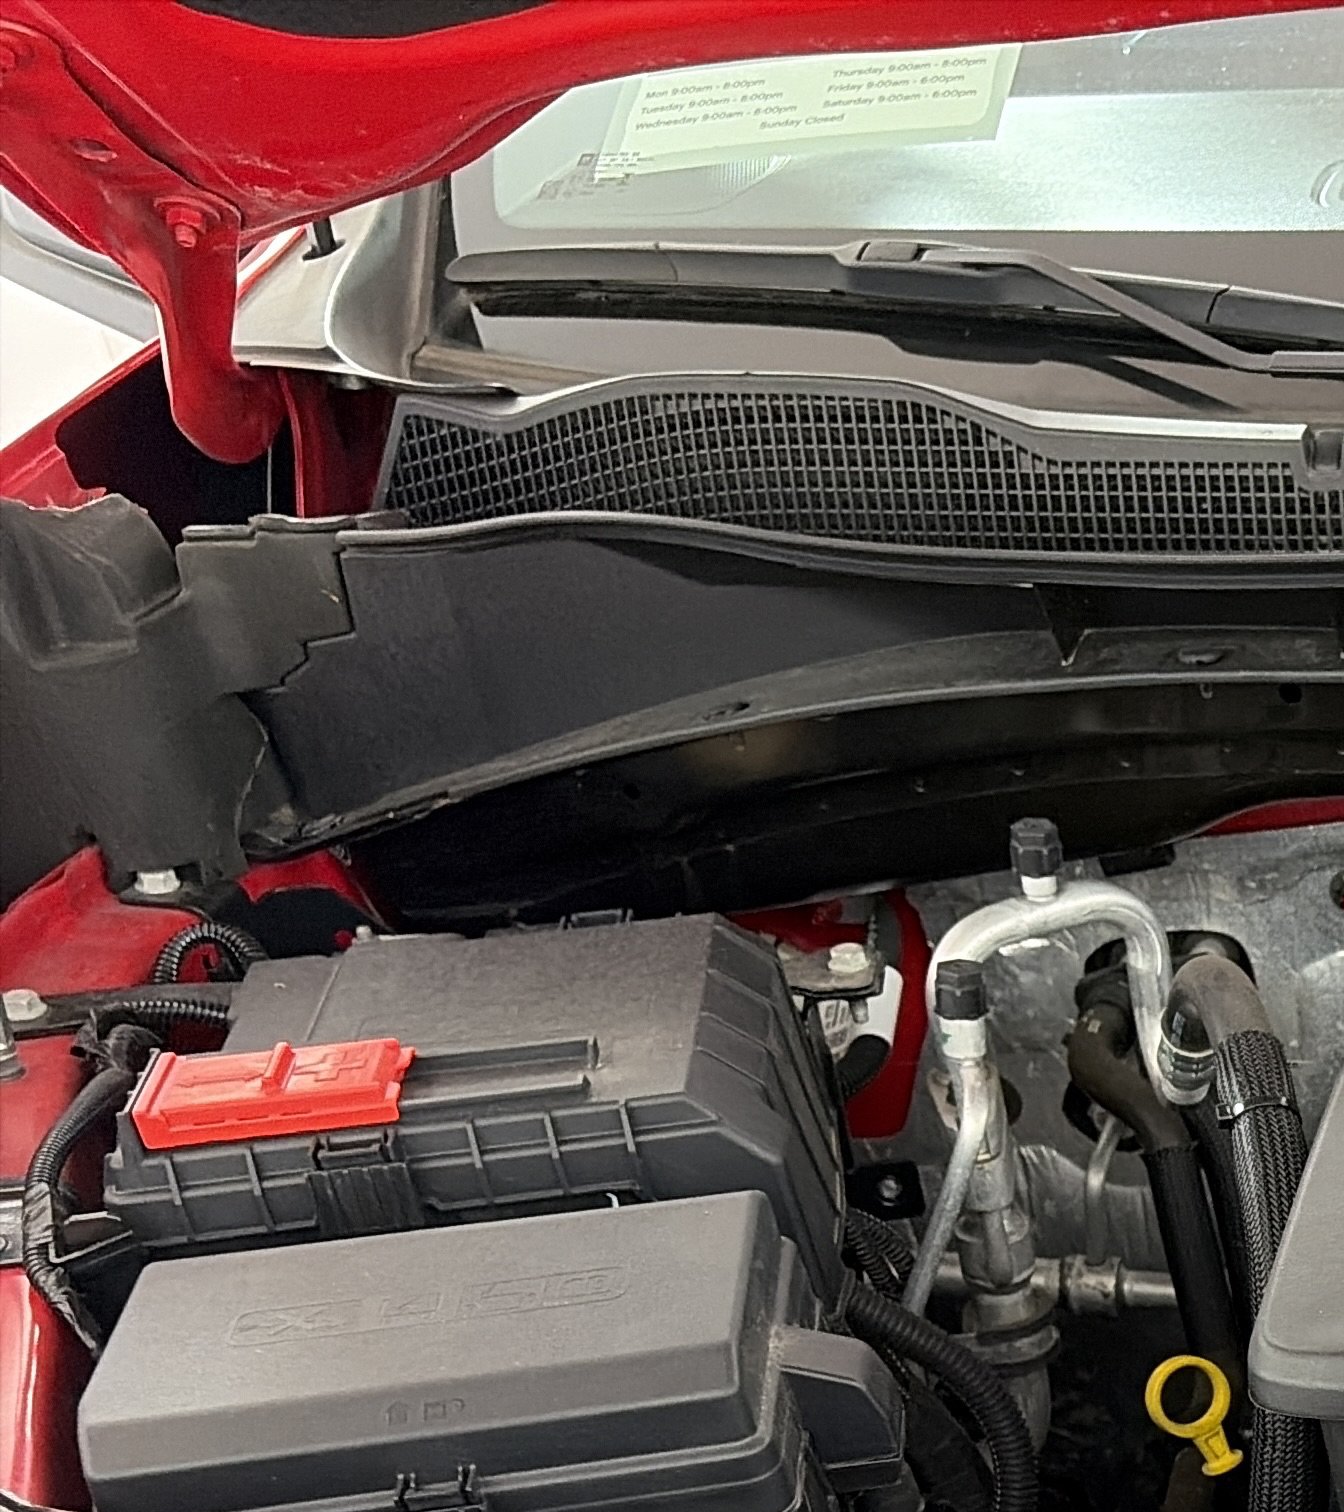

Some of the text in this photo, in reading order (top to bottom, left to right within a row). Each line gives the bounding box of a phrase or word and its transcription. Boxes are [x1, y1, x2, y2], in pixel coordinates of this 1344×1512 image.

[833, 65, 884, 78] Thursday
[888, 62, 931, 73] 9:00am
[645, 89, 668, 99] Mon
[671, 83, 712, 96] 9:00am
[827, 82, 864, 93] Friday
[866, 79, 909, 90] 9:00am
[641, 102, 685, 115] Tuesday
[688, 97, 730, 109] 9:00am
[822, 96, 874, 109] Saturday
[878, 92, 921, 104] 9:00am
[635, 115, 698, 131] Wednesday
[701, 110, 744, 122] 9:00am
[759, 112, 845, 130] Sunday Closed
